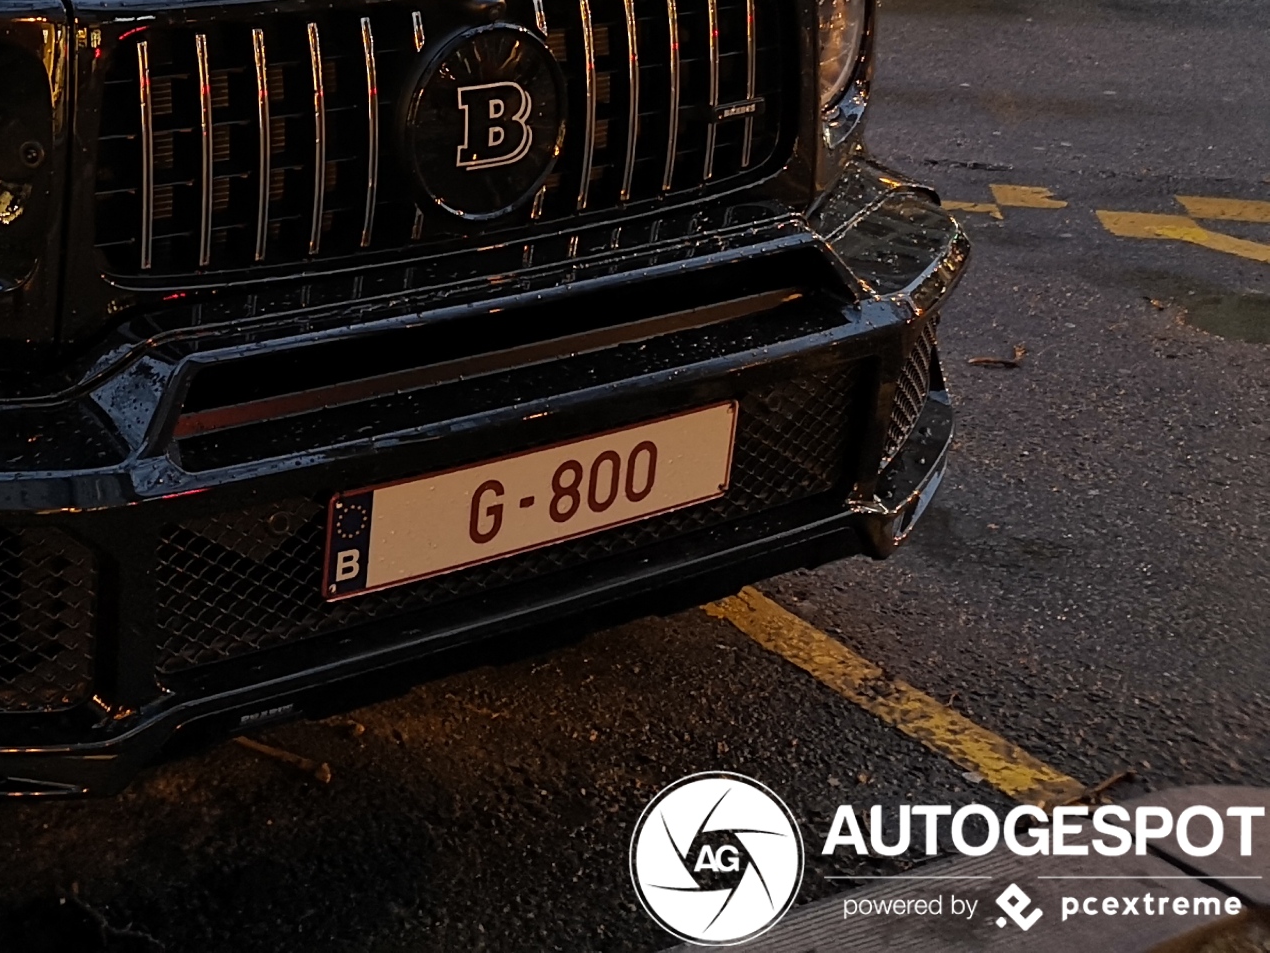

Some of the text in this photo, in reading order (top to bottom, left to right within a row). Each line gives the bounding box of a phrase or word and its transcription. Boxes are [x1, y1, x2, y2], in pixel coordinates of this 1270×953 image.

[457, 81, 532, 171] B
[469, 440, 658, 545] G-800
[335, 548, 360, 583] B
